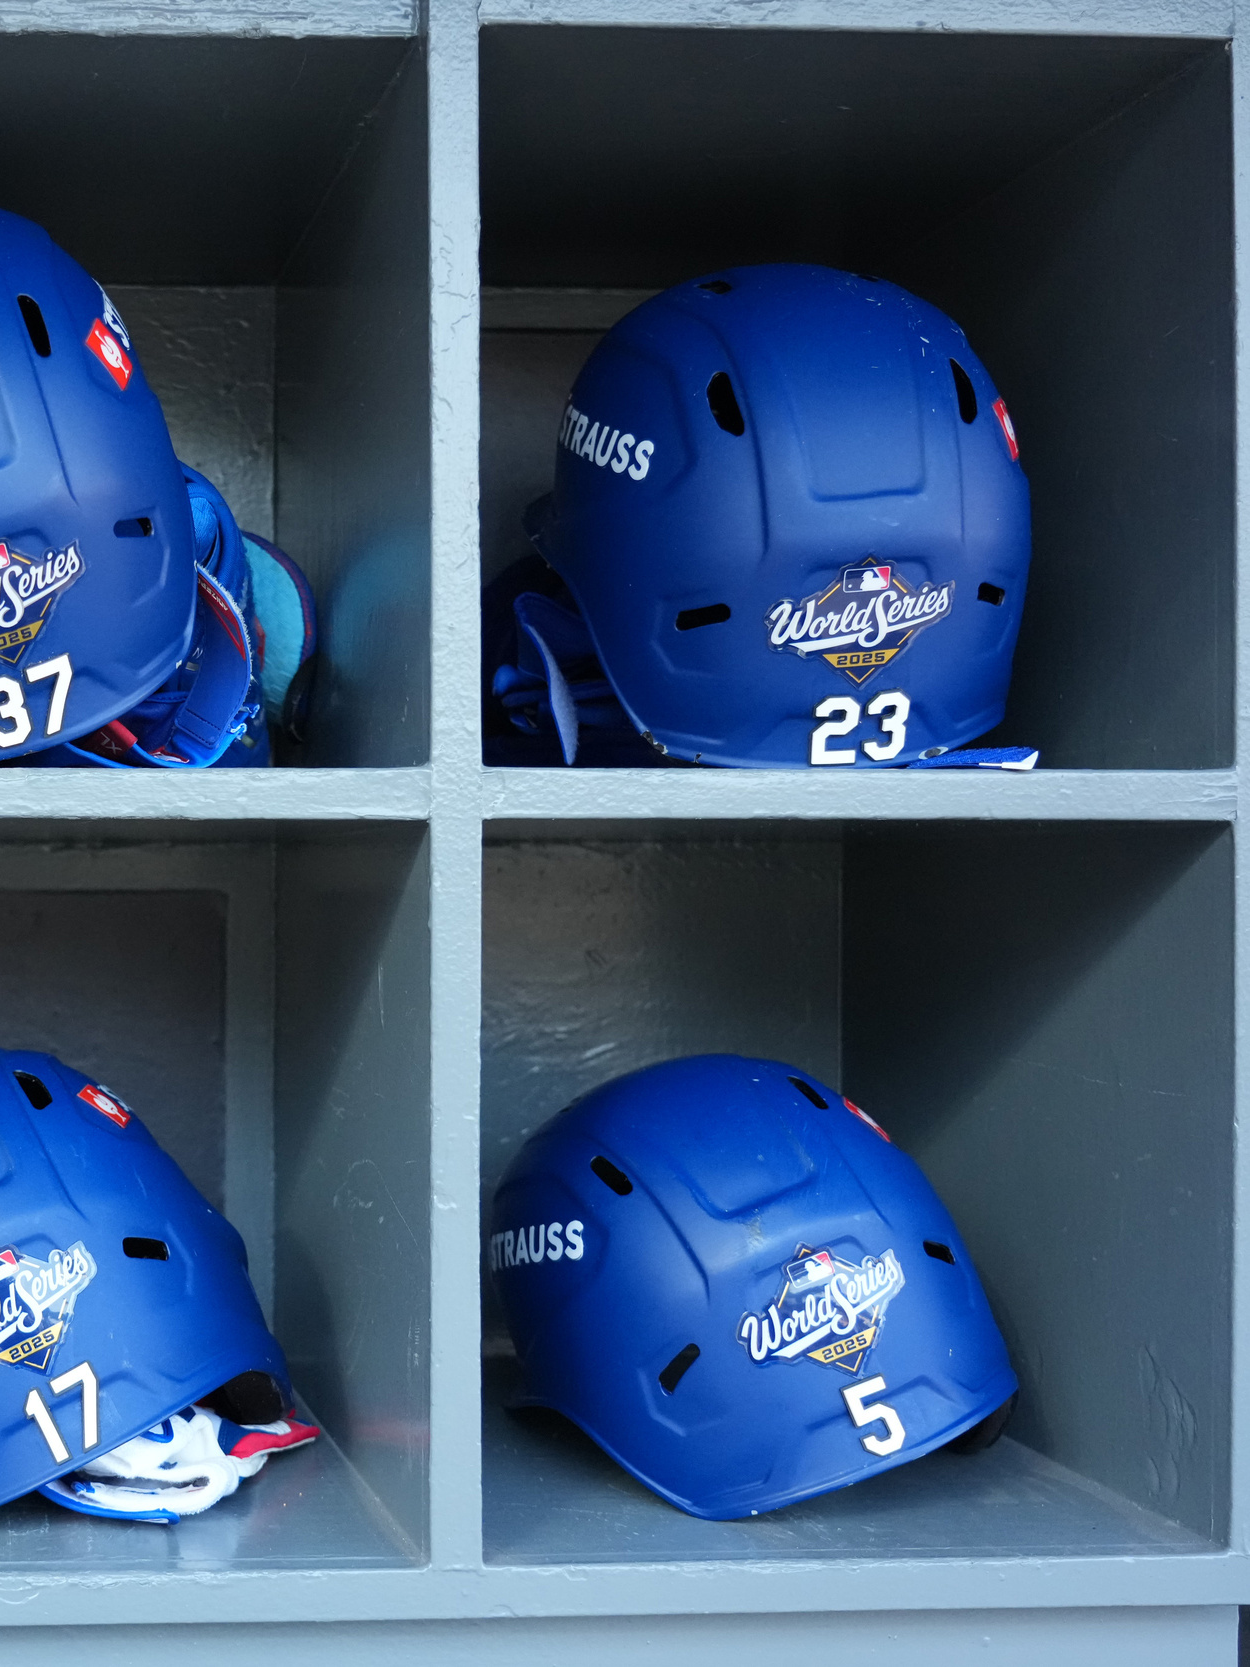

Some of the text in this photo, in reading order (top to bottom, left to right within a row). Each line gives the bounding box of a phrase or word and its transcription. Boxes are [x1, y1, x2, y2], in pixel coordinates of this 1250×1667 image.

[769, 586, 950, 648] World Series
[836, 651, 886, 666] 2025
[810, 690, 911, 765] 23
[491, 1219, 585, 1272] STRAUSS
[15, 1248, 89, 1333] Series
[741, 1256, 899, 1361] World Series
[9, 1330, 55, 1361] 2025
[821, 1334, 868, 1361] 2025
[24, 1361, 98, 1464] 17
[842, 1375, 907, 1457] 5
